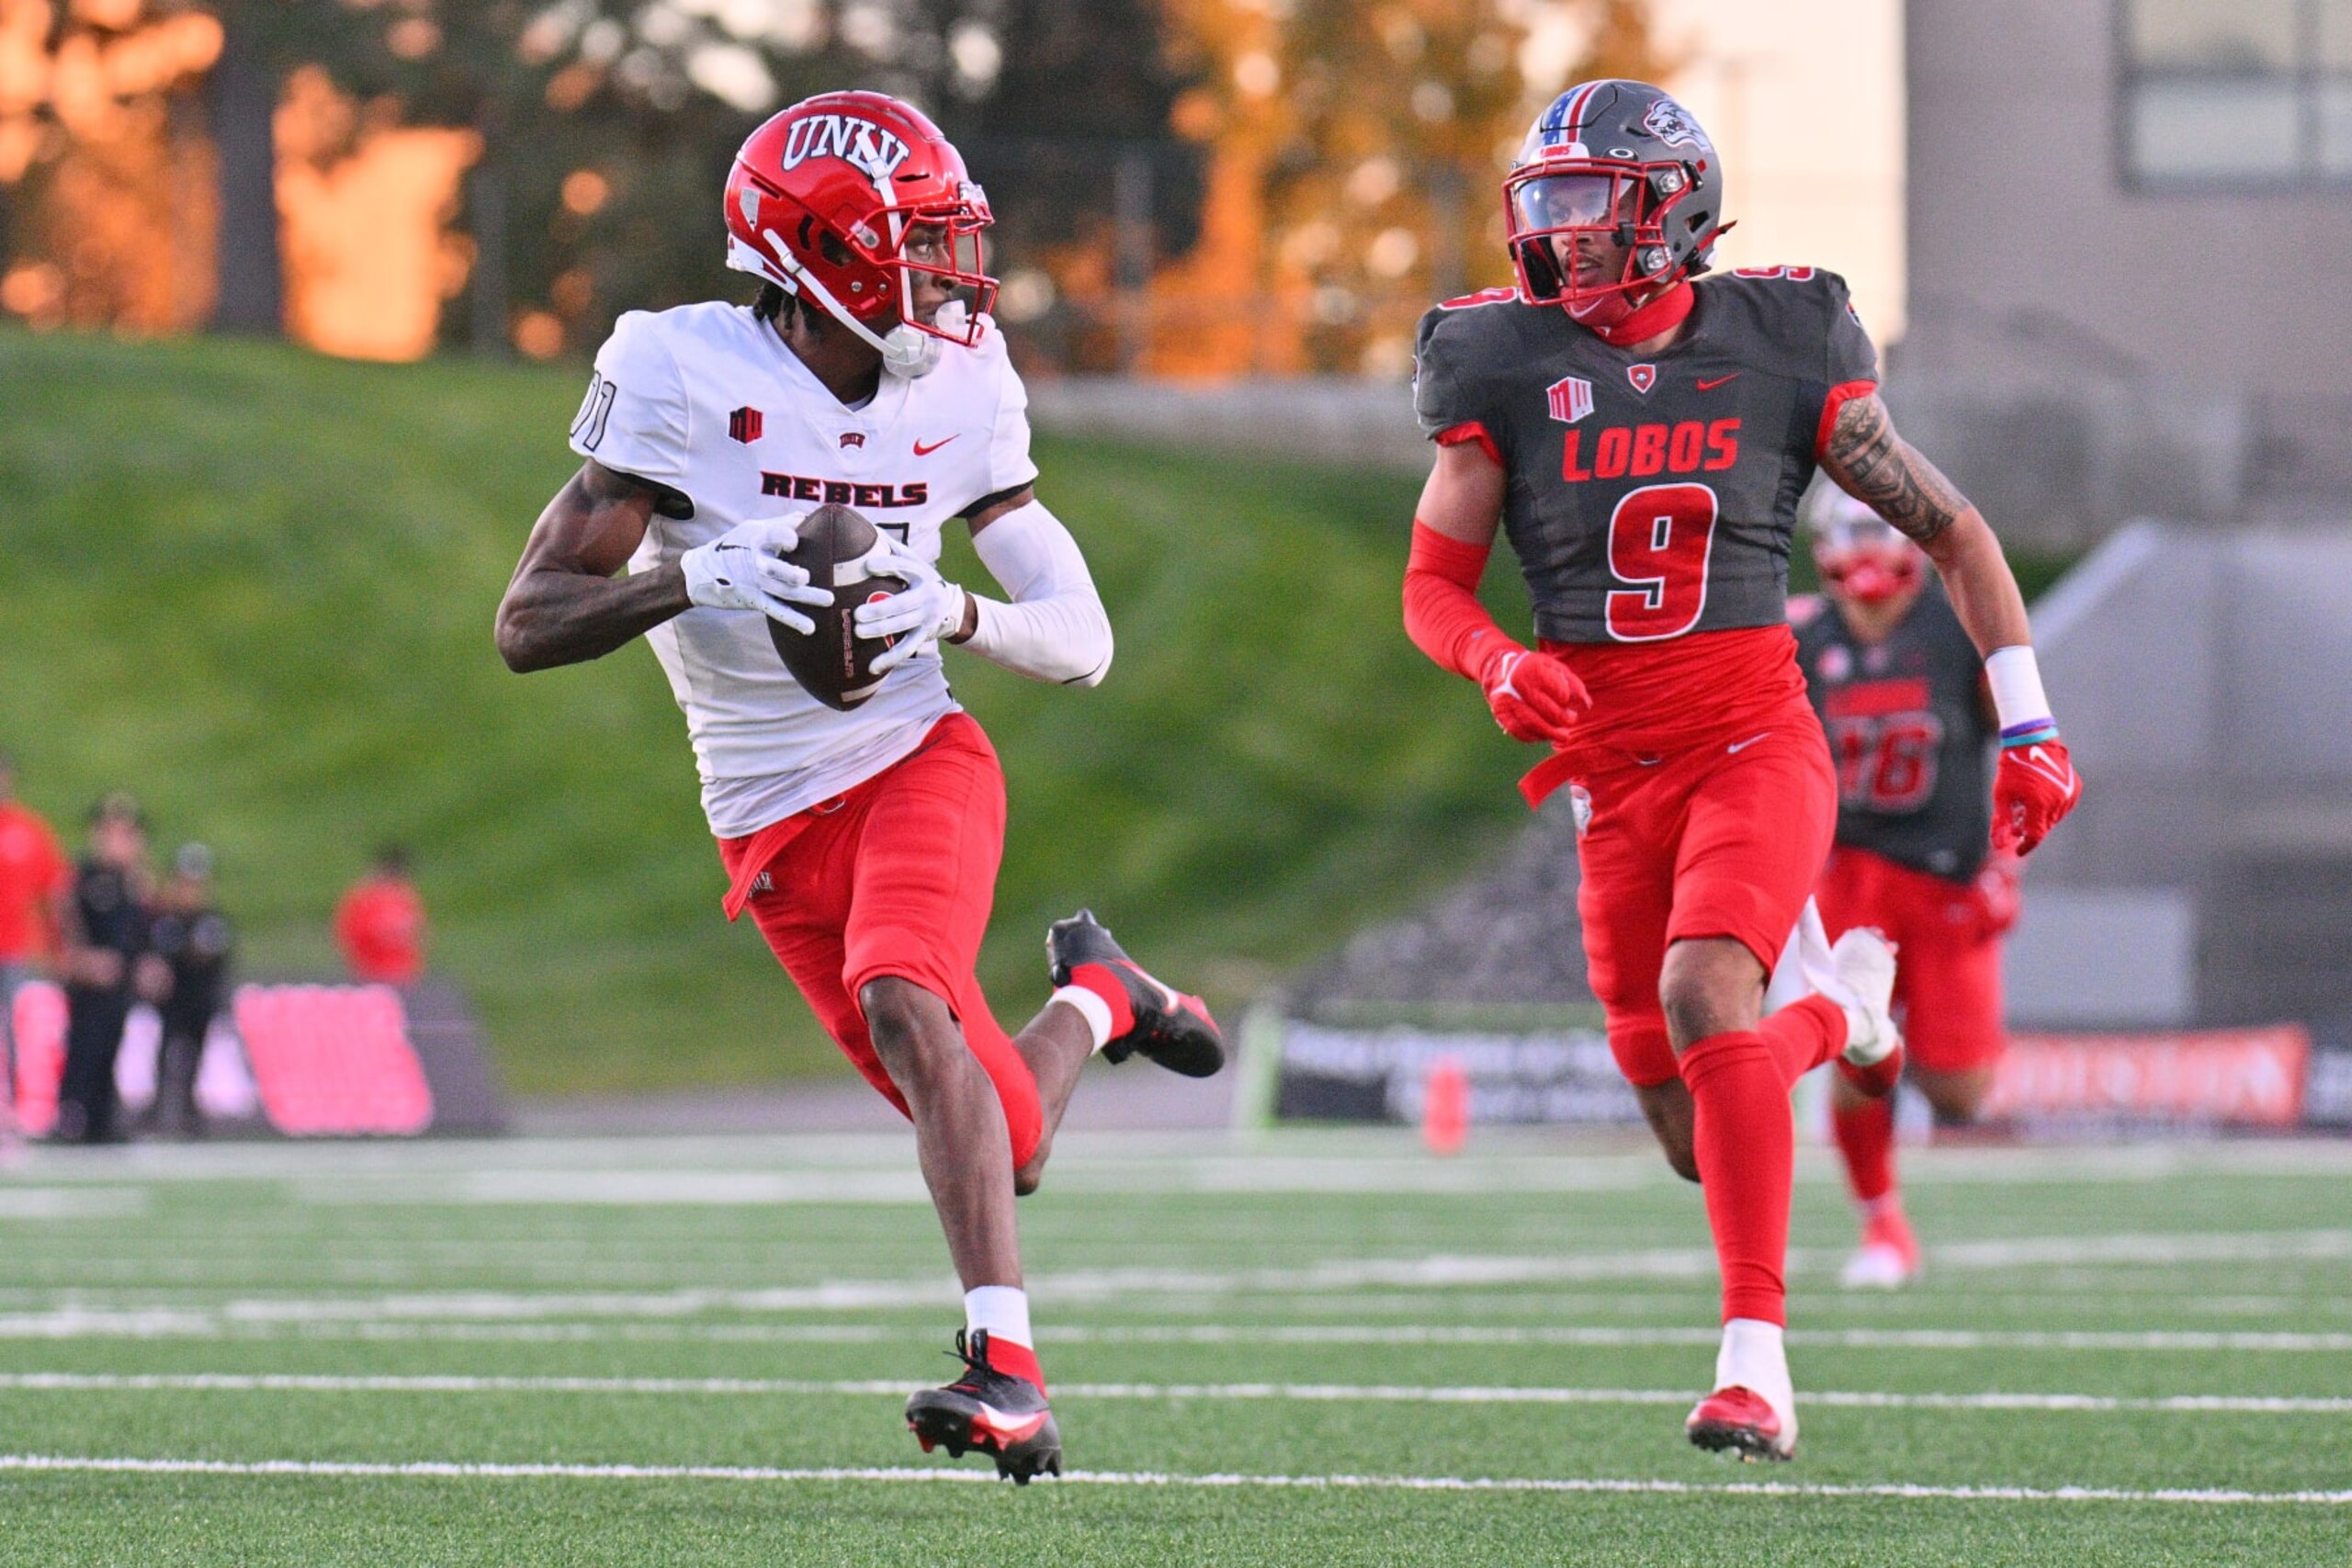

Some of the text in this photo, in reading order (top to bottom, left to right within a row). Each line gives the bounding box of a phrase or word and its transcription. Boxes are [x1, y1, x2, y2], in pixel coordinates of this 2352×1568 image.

[782, 112, 910, 191] UNLV
[1562, 418, 1742, 483] LOBOS
[760, 470, 928, 508] REBELS
[1604, 481, 1719, 642] 9
